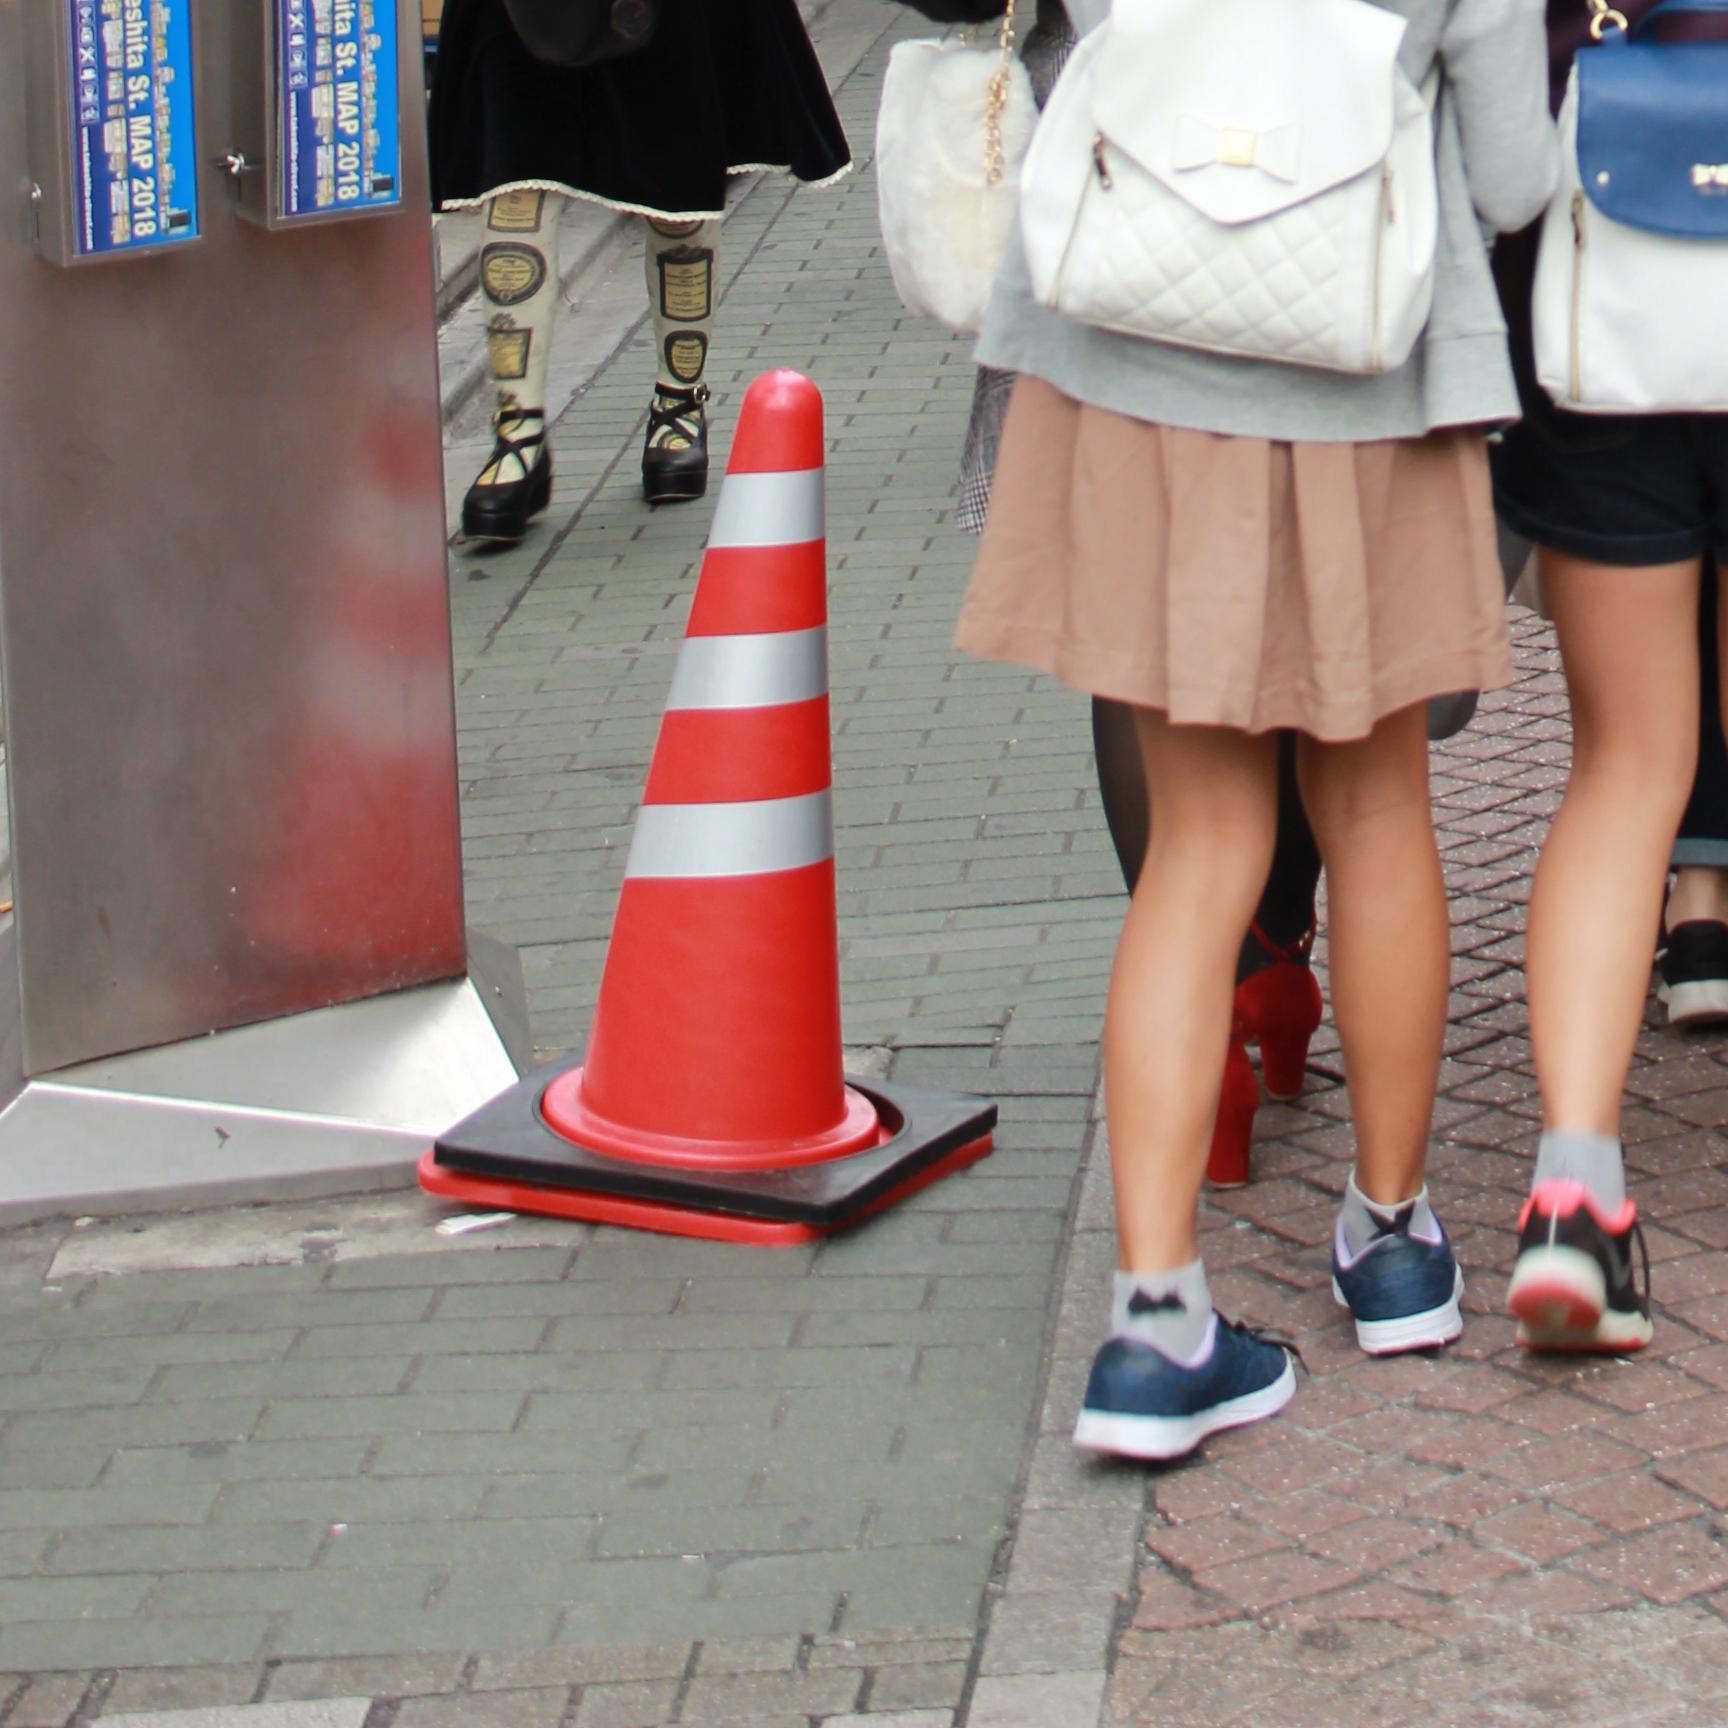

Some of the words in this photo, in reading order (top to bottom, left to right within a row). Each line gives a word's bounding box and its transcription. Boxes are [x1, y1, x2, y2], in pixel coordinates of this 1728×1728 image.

[334, 42, 357, 77] St.
[126, 72, 151, 110] St.
[336, 81, 360, 136] MAP
[127, 116, 153, 171] MAP
[337, 142, 360, 200] 2018
[132, 176, 157, 238] 2018
